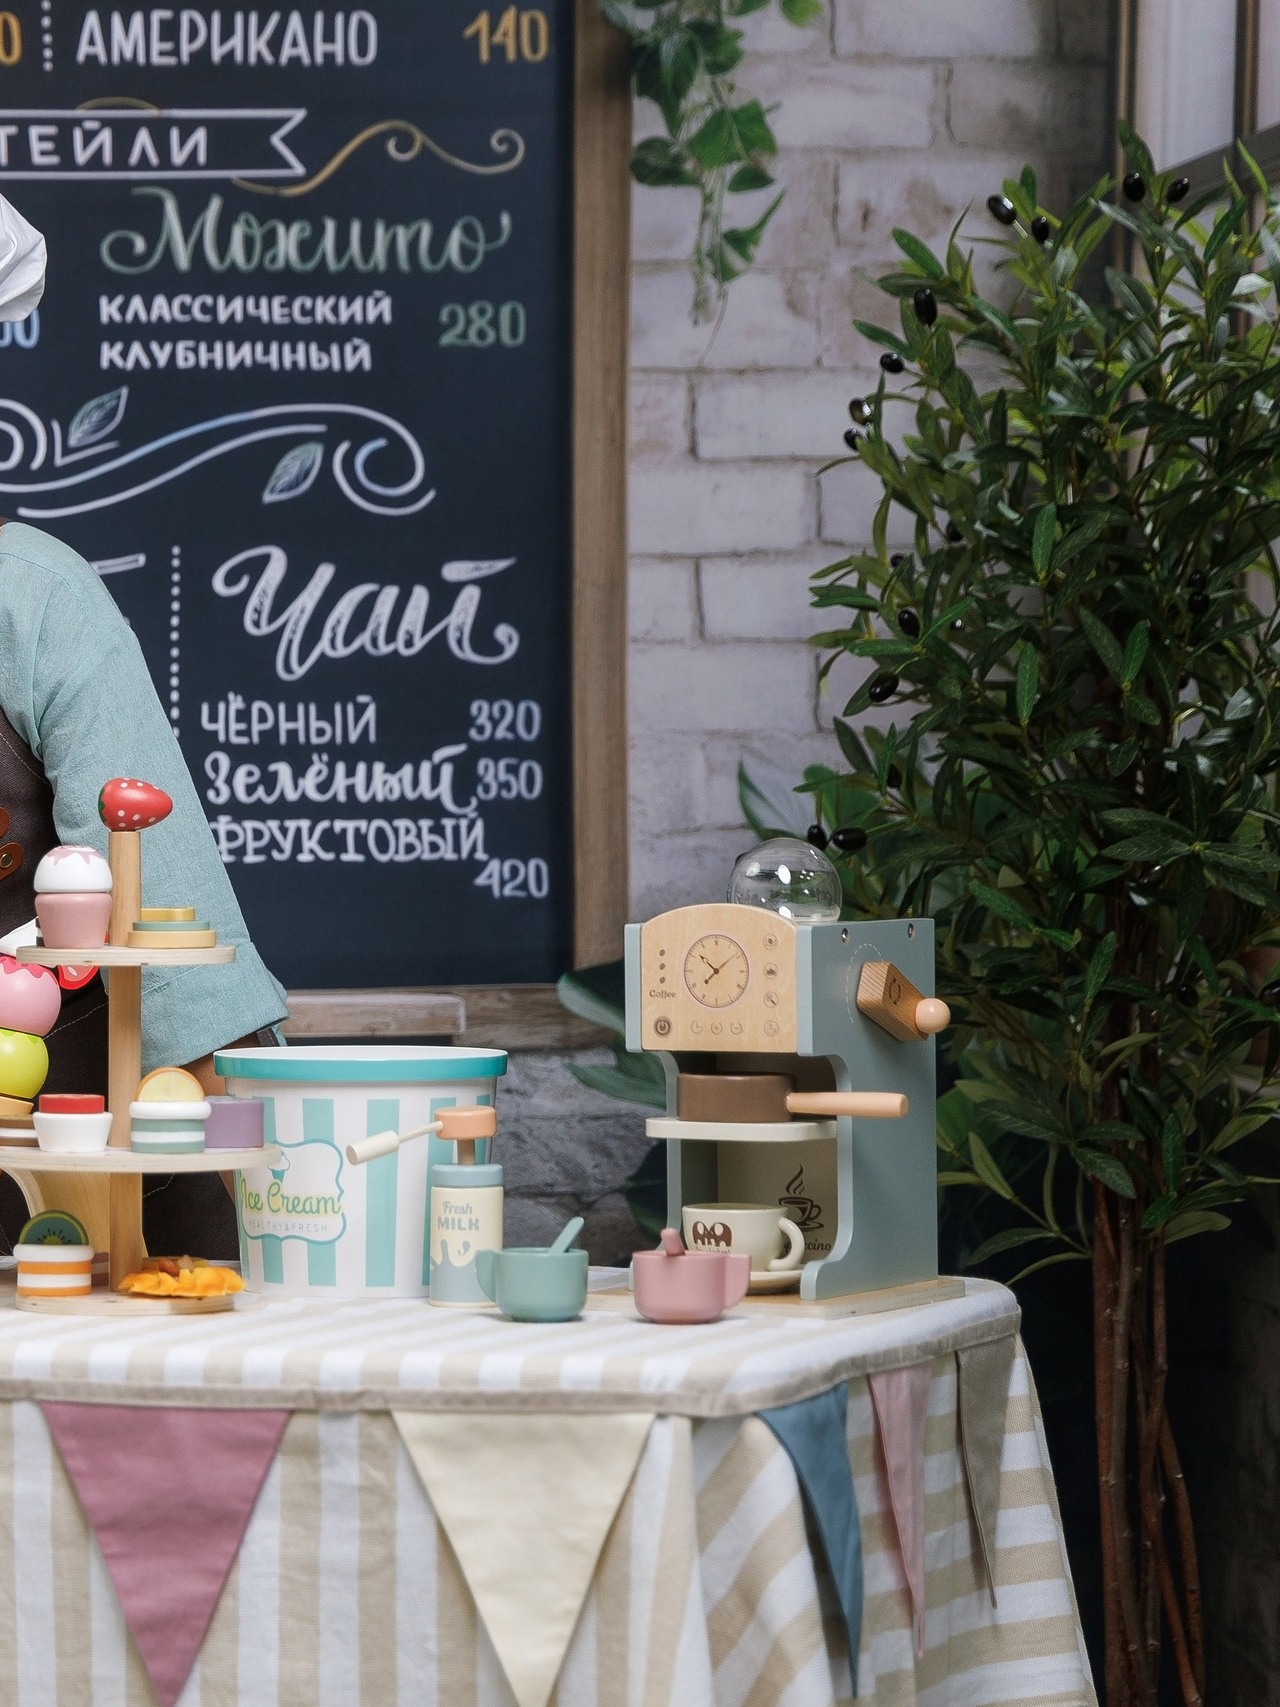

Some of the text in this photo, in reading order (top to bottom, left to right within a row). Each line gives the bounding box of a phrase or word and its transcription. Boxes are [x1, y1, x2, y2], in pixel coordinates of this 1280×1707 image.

[76, 5, 550, 66] АМЕРИКАНО 140
[99, 185, 512, 275] Можито
[99, 290, 527, 347] КЛАССИЧЕСКИЙ 280
[100, 338, 372, 372] КЛУБНИЧНЫЙ
[212, 545, 520, 681] Чай
[201, 691, 542, 745] ЧЁРНЫЙ 320
[204, 743, 543, 815] Зелёный 350
[210, 811, 550, 899] ФРУКТОВЫЙ 420
[241, 1178, 341, 1215] Ice Cream
[437, 1216, 480, 1231] MILK
[442, 1201, 473, 1215] Fresh
